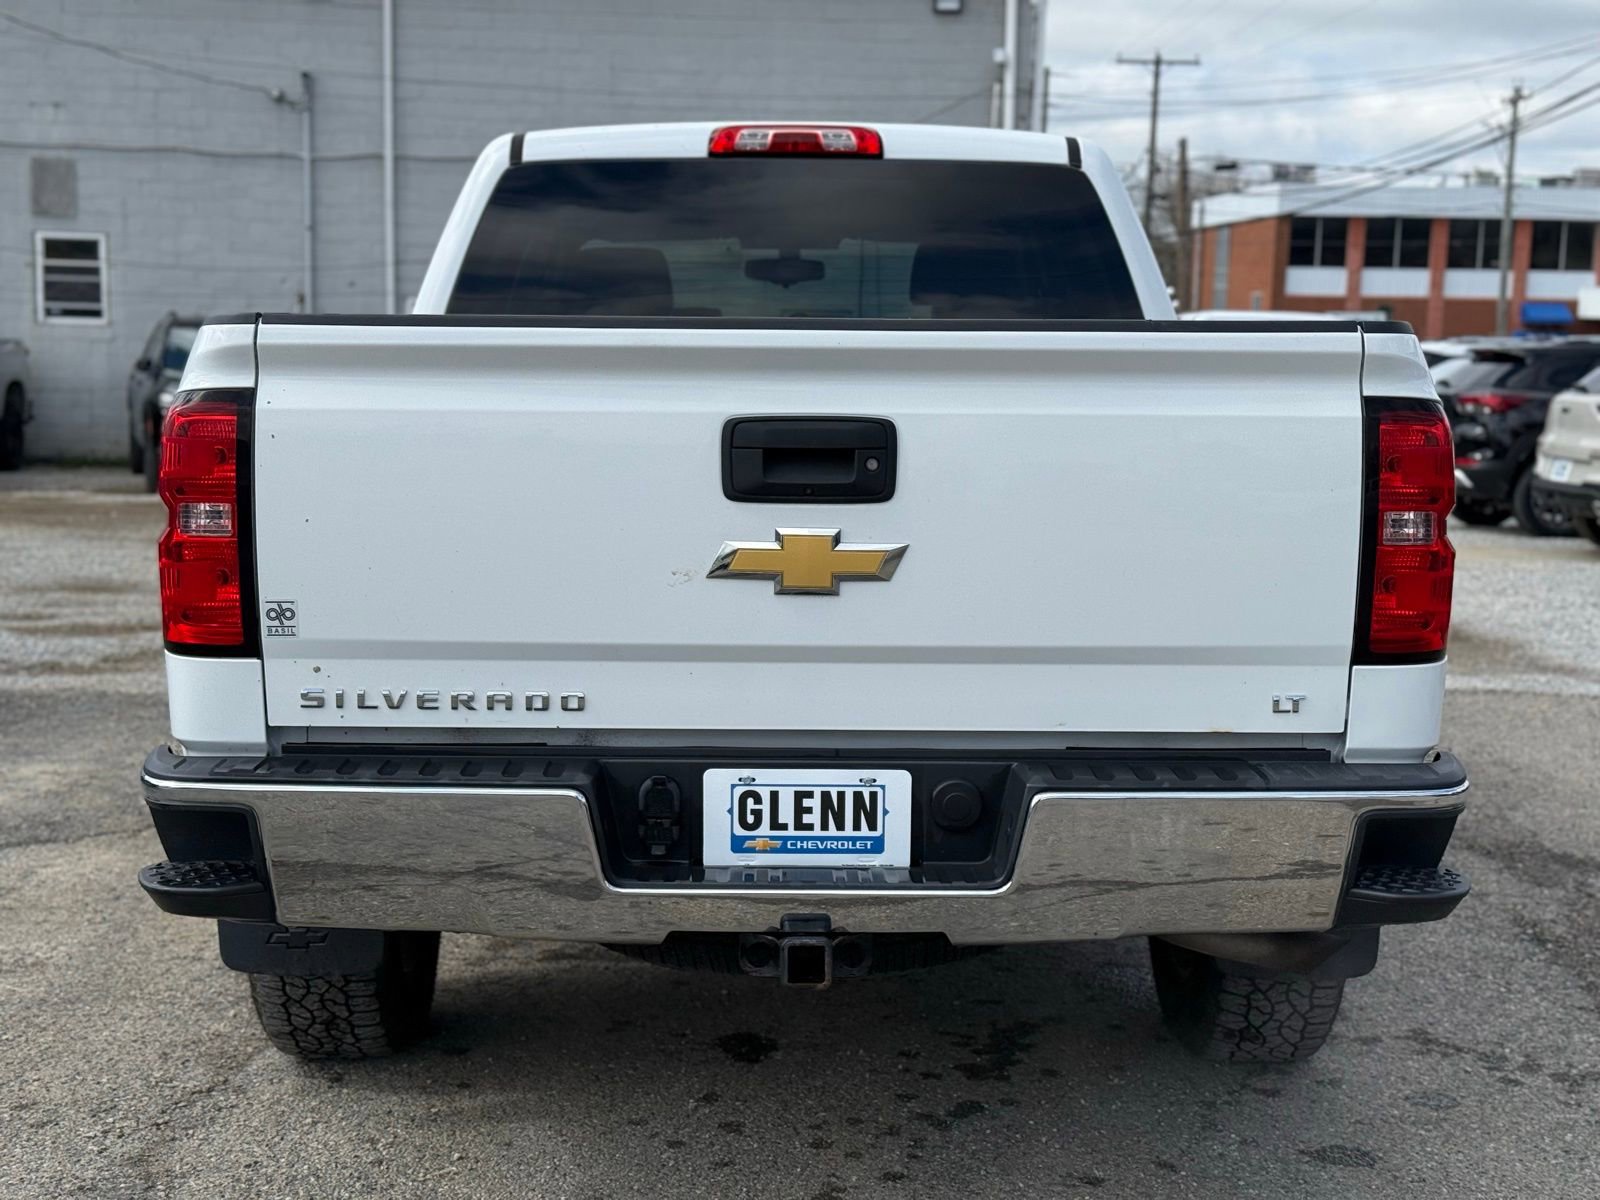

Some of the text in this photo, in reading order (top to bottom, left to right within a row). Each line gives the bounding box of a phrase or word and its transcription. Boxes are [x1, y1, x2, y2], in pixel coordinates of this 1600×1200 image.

[300, 688, 586, 712] SILVERADO
[1272, 693, 1306, 713] LT
[738, 789, 878, 832] GLENN
[786, 840, 873, 849] CHEVROLET
